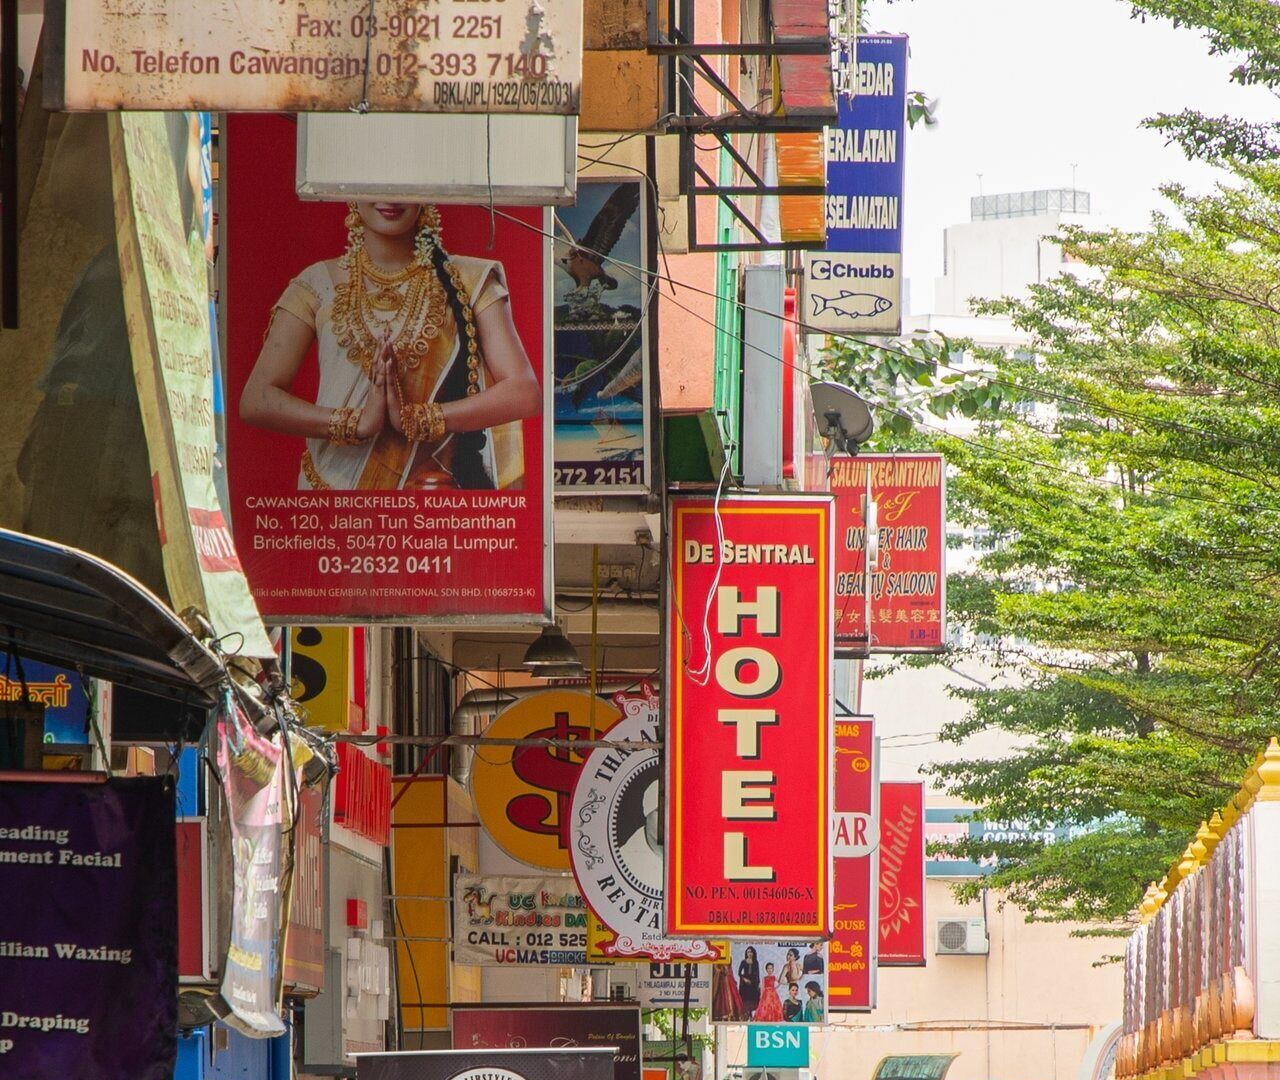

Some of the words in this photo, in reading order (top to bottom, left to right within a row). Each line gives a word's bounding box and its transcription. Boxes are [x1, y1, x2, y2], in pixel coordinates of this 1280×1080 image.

[297, 15, 342, 38] Fax:
[351, 14, 440, 39] 03-9021
[453, 15, 502, 39] 2251
[82, 49, 120, 74] No.
[133, 49, 219, 74] Telefon
[377, 53, 476, 76] 012-393
[487, 53, 546, 77] 7140
[828, 129, 896, 162] ERALATAN
[833, 263, 894, 279] Chubb
[590, 466, 644, 485] 2151
[245, 497, 329, 509] CAWANGAN
[334, 496, 419, 510] BRICKFIELDS,
[424, 497, 468, 509] KUALA
[473, 497, 527, 508] LUMPUR
[256, 515, 285, 530] No.
[290, 515, 324, 532] 120,
[329, 515, 373, 530] Jalan
[378, 515, 409, 530] Tun
[413, 515, 516, 530] Sambanthan
[253, 535, 340, 553] Brickfields,
[346, 535, 397, 550] 50470
[402, 535, 448, 551] Kuala
[453, 535, 518, 554] Lumpur.
[318, 556, 399, 574] 03-2632
[406, 556, 452, 573] 0411
[882, 553, 891, 570] &
[271, 589, 289, 597] oleh
[291, 589, 326, 597] RIMBUN
[328, 589, 367, 597] GEMBIRA
[370, 589, 438, 597] INTERNATIONAL
[440, 589, 459, 597] SDN
[460, 589, 483, 597] BHD.
[715, 585, 782, 883] HOTEL
[58, 850, 122, 868] Facial
[596, 875, 660, 929] RESTA
[686, 887, 707, 899] NO.
[712, 888, 739, 899] PEN.
[743, 888, 813, 899] 001546056-X
[468, 932, 509, 946] CALL
[527, 932, 553, 946] 012
[55, 943, 132, 964] Waxing
[496, 949, 549, 964] UCMAS
[1, 1011, 90, 1033] Draping
[755, 1028, 801, 1050] BSN
